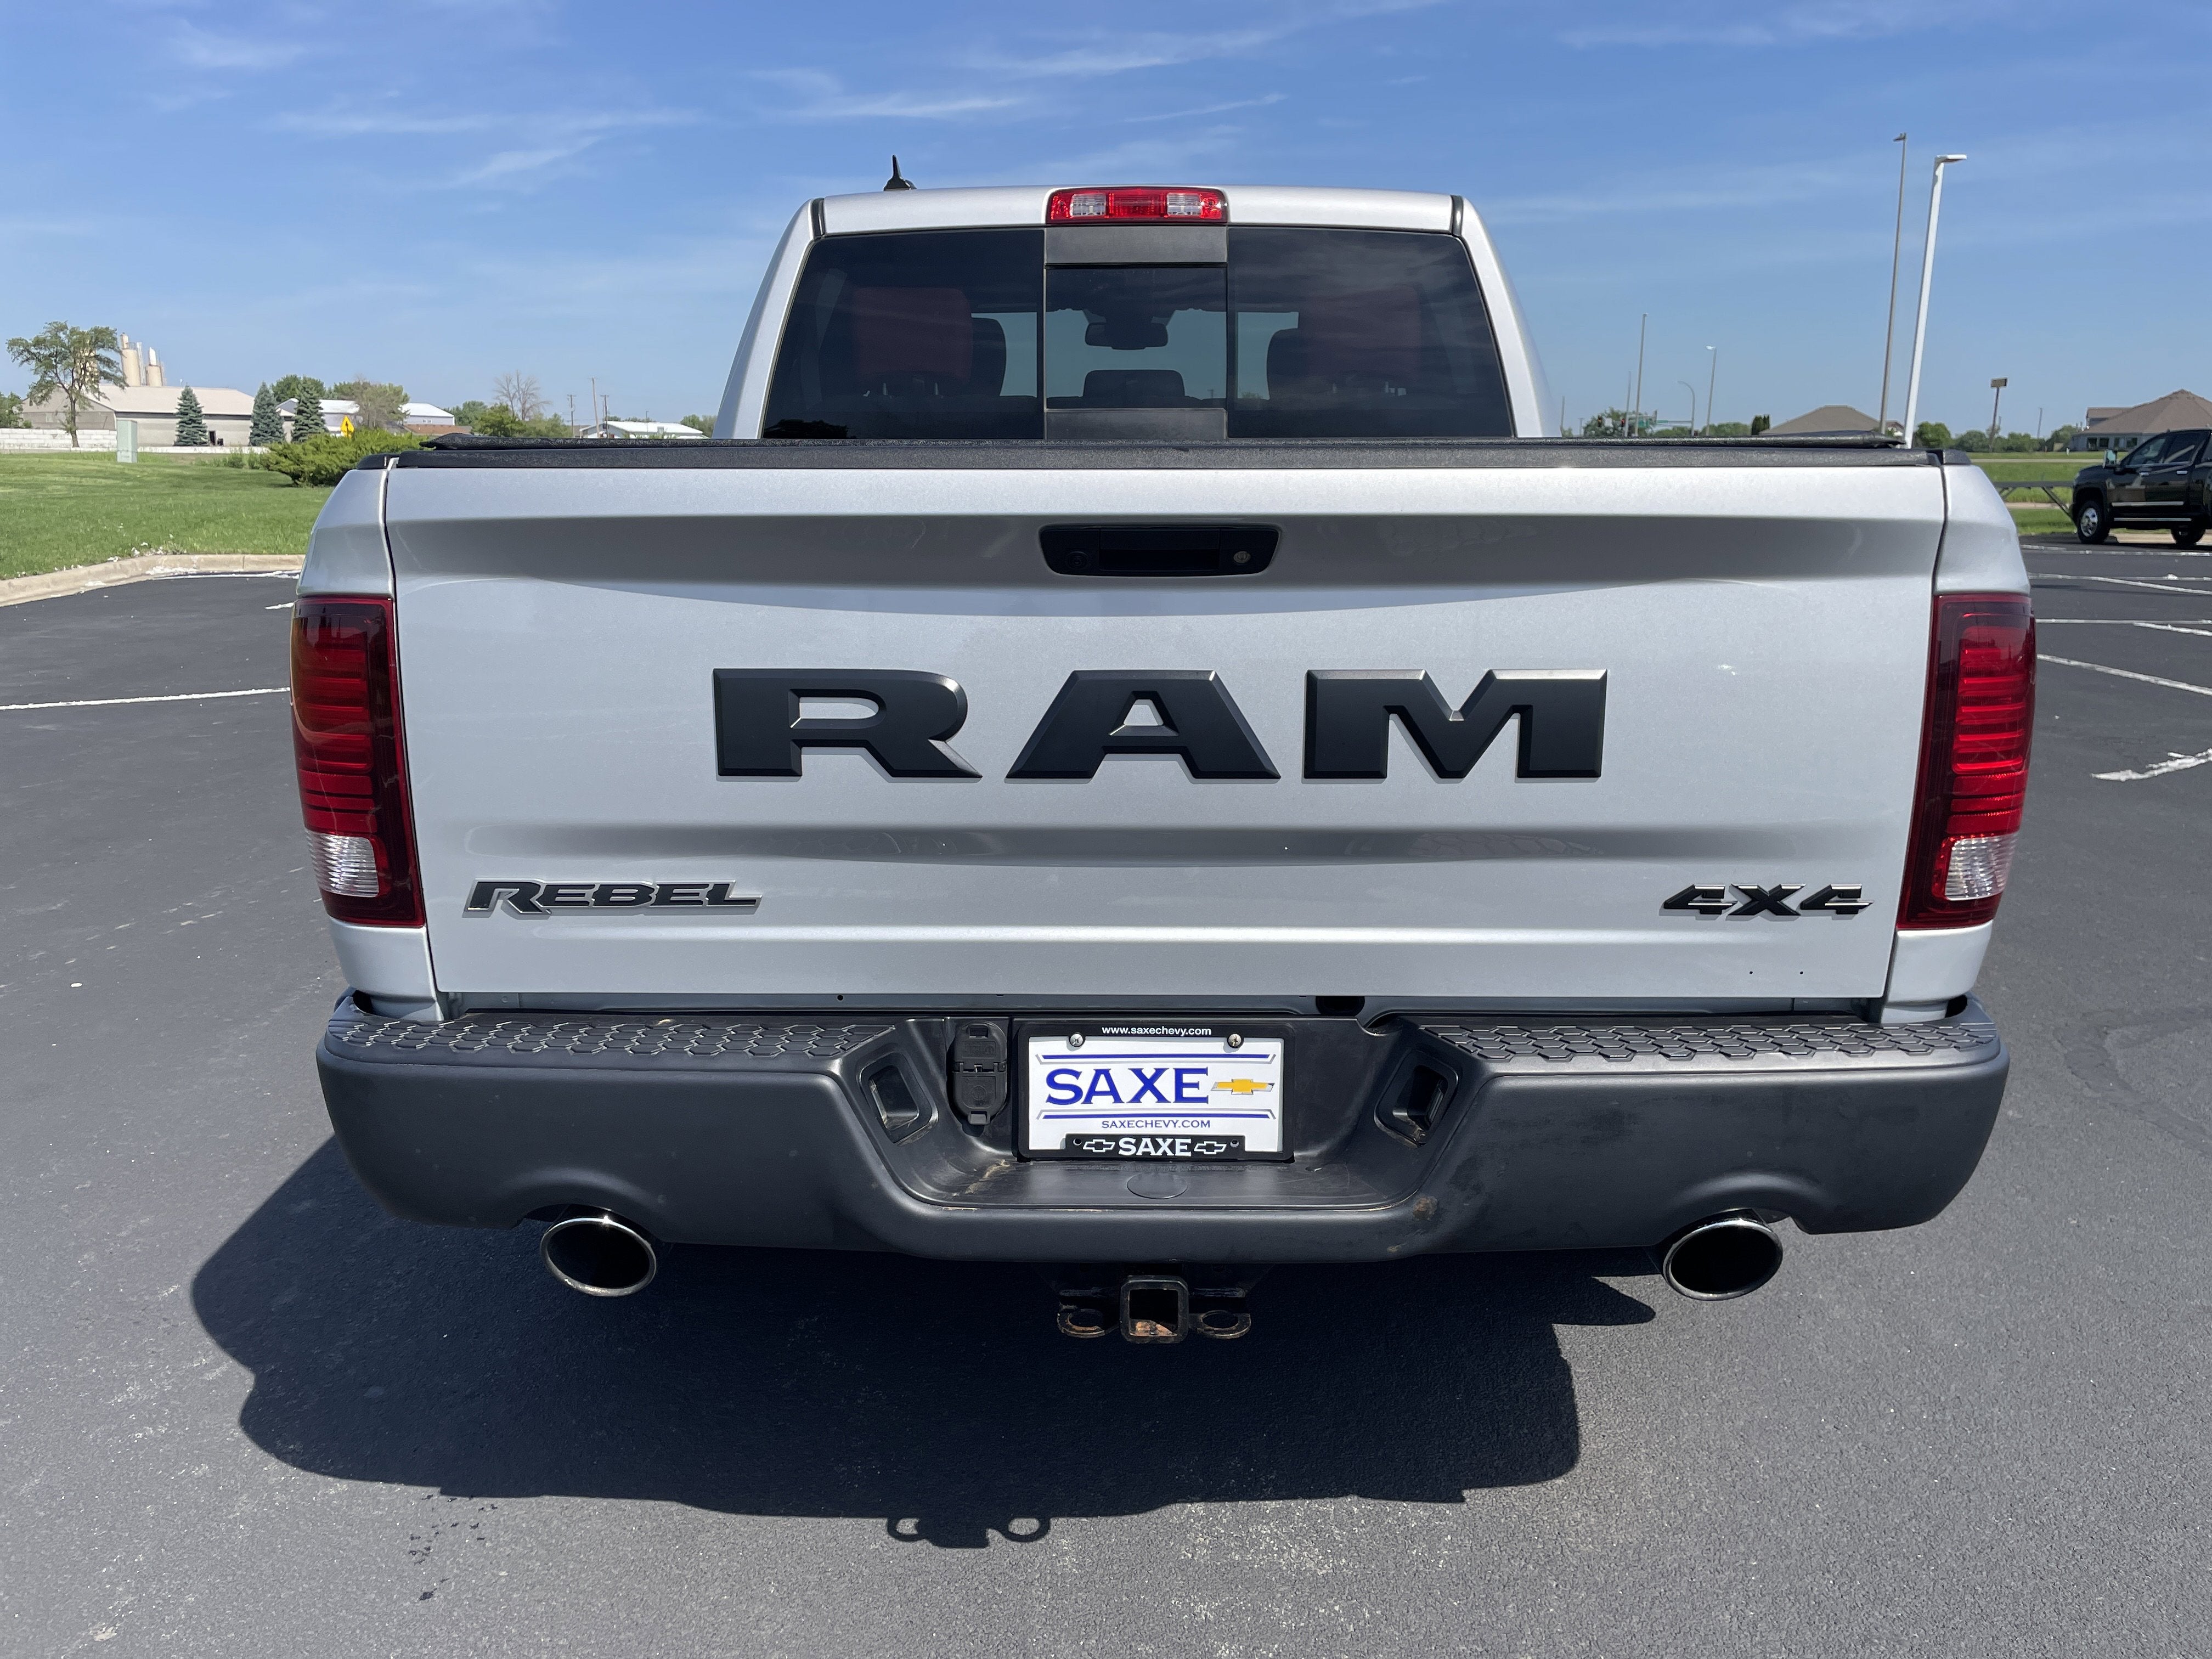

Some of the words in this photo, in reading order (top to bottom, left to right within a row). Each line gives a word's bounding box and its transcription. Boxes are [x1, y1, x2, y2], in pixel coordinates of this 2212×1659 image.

[713, 668, 1608, 779] RAM
[466, 878, 763, 914] REBEL
[1101, 1025, 1212, 1036] www.saxechevy.com
[1045, 1066, 1209, 1105] SAXE
[1101, 1120, 1211, 1128] SAXECHEVY.COM
[1118, 1137, 1192, 1157] SAXE
